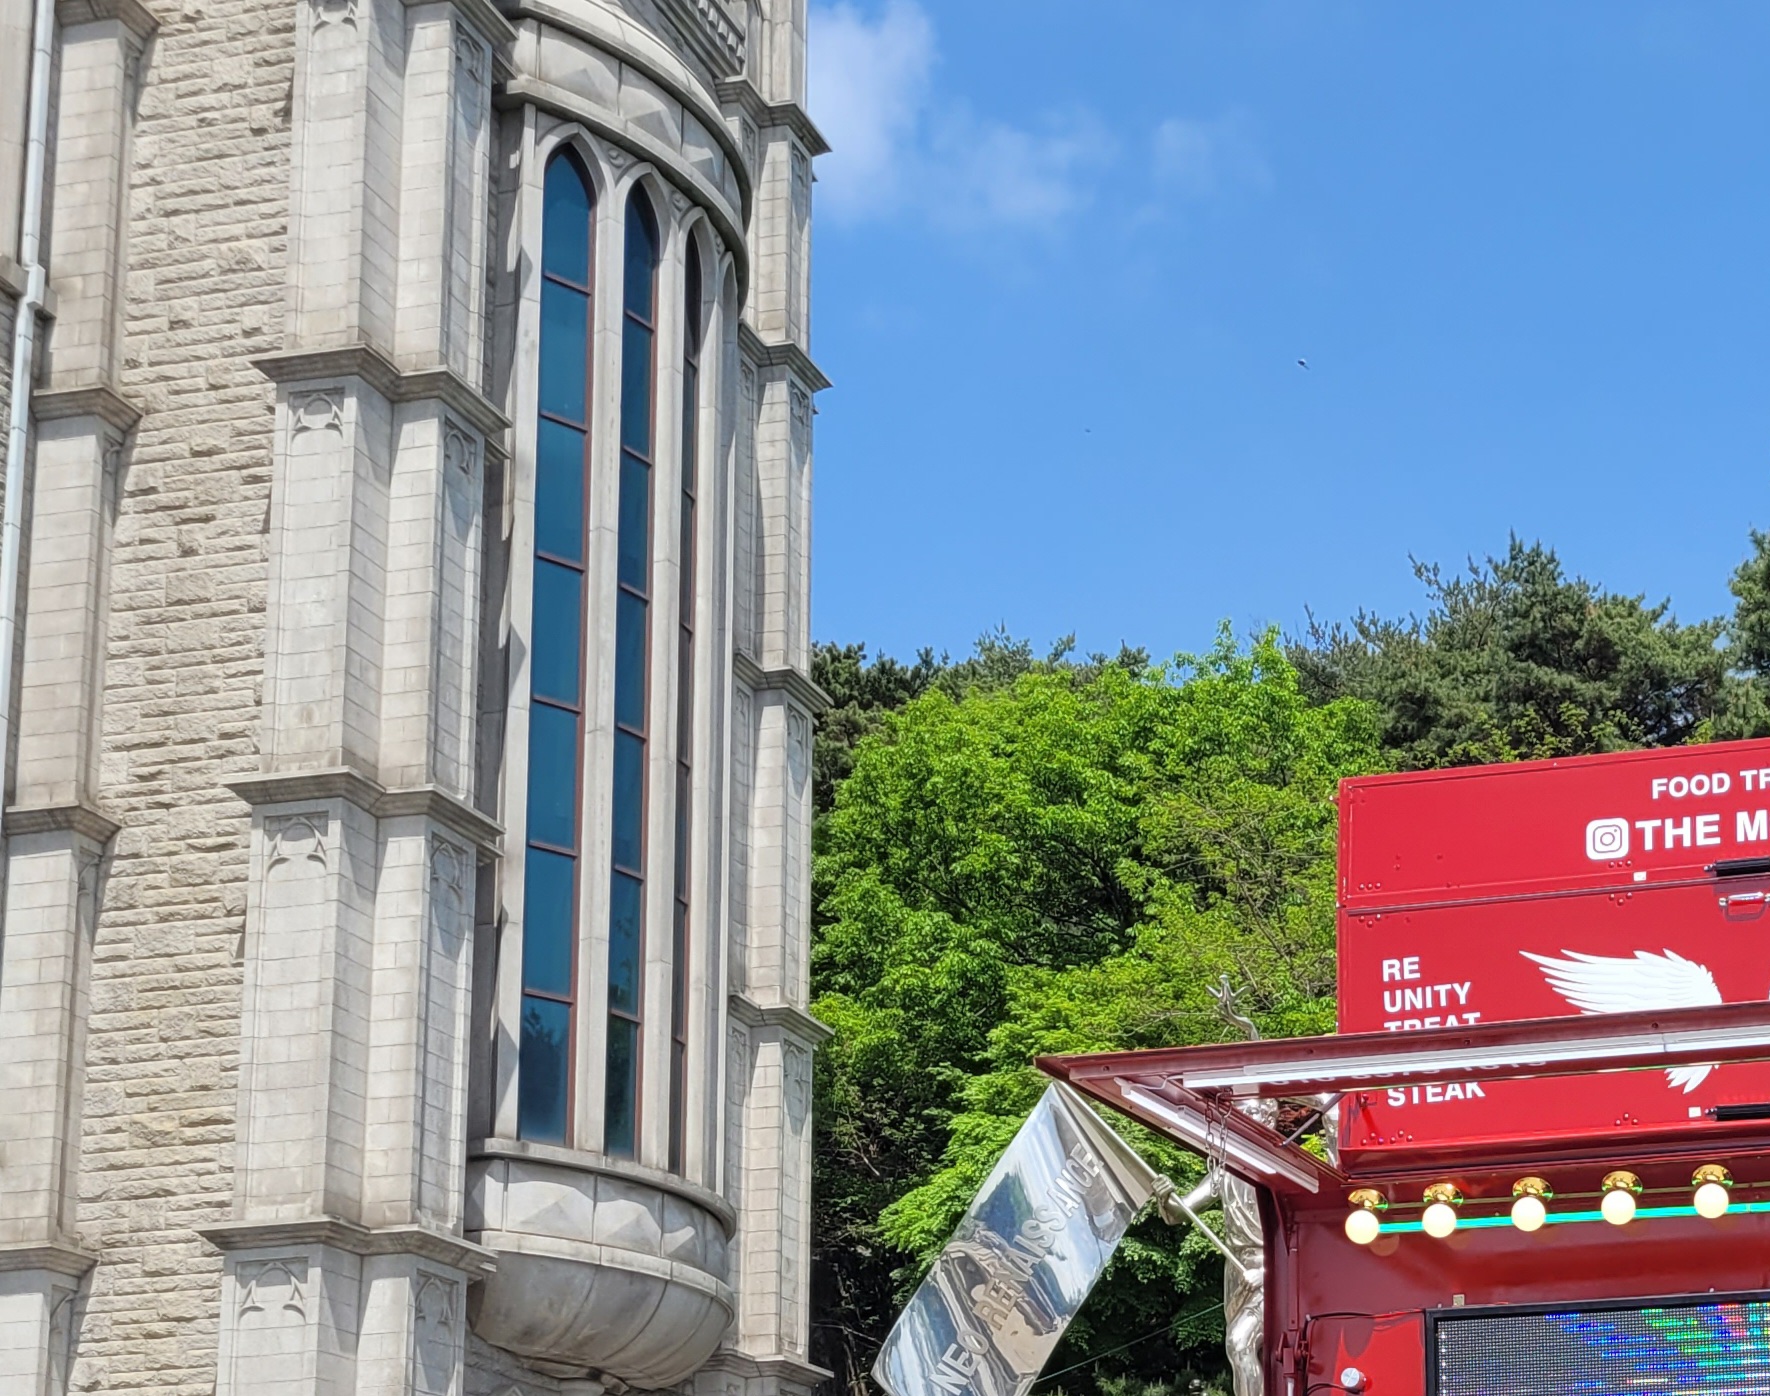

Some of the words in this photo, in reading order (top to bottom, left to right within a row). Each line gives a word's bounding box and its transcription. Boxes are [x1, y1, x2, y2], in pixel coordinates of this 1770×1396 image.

[1652, 772, 1731, 799] FOOD
[1636, 812, 1720, 851] THE
[1382, 956, 1421, 982] RE
[1384, 982, 1471, 1013] UNITY
[1387, 1082, 1486, 1107] STEAK
